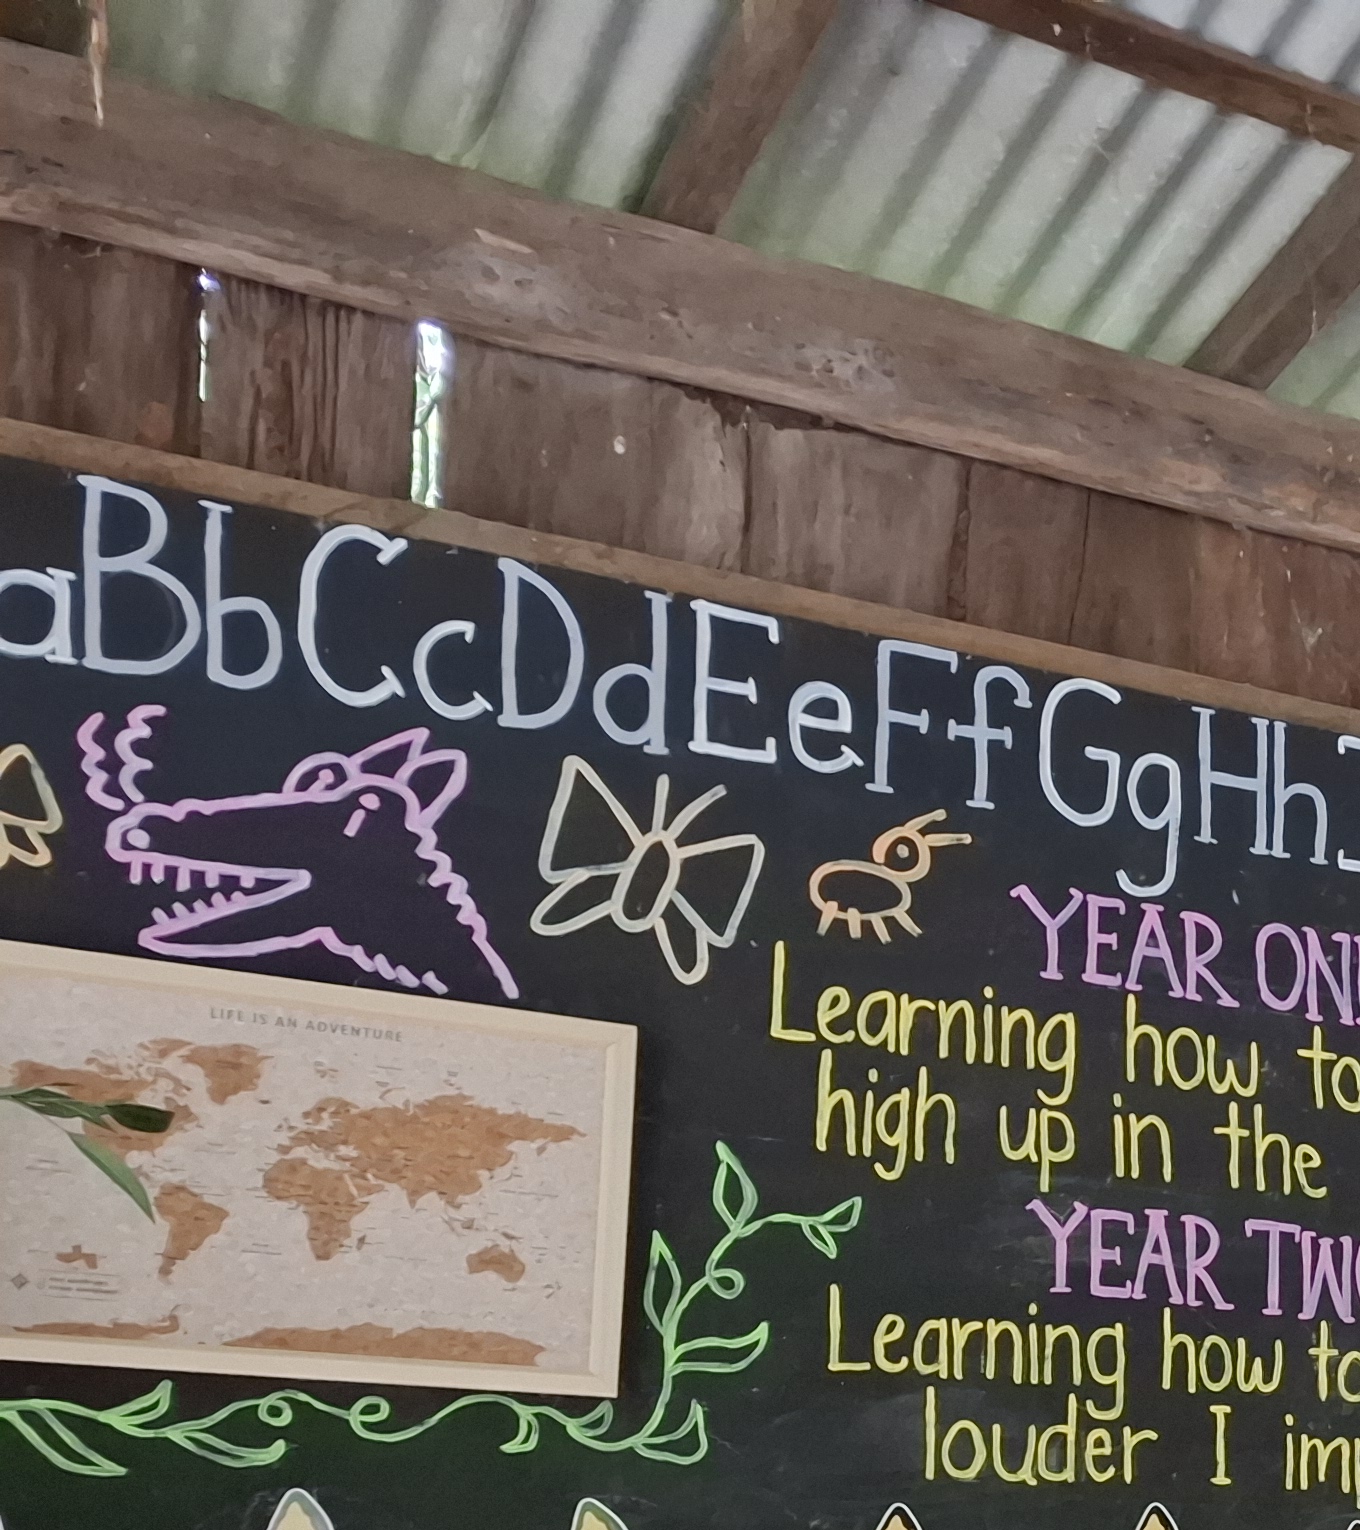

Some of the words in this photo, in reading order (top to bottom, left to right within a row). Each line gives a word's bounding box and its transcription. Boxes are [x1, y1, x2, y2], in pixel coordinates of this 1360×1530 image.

[1009, 884, 1241, 1009] YEAR
[210, 1006, 244, 1022] LIFE
[252, 1013, 267, 1025] IS
[274, 1016, 297, 1028] AN
[305, 1020, 403, 1042] ADVENTURE
[770, 941, 1076, 1105] Learning
[1125, 993, 1261, 1097] how
[814, 1048, 956, 1181] high
[999, 1102, 1075, 1193] up
[1114, 1093, 1172, 1183] in
[1214, 1101, 1328, 1199] the
[1026, 1197, 1234, 1313] YEAR
[827, 1283, 1126, 1420] Learning
[1161, 1306, 1283, 1395] how
[925, 1385, 1158, 1487] louder
[1208, 1405, 1232, 1486] I
